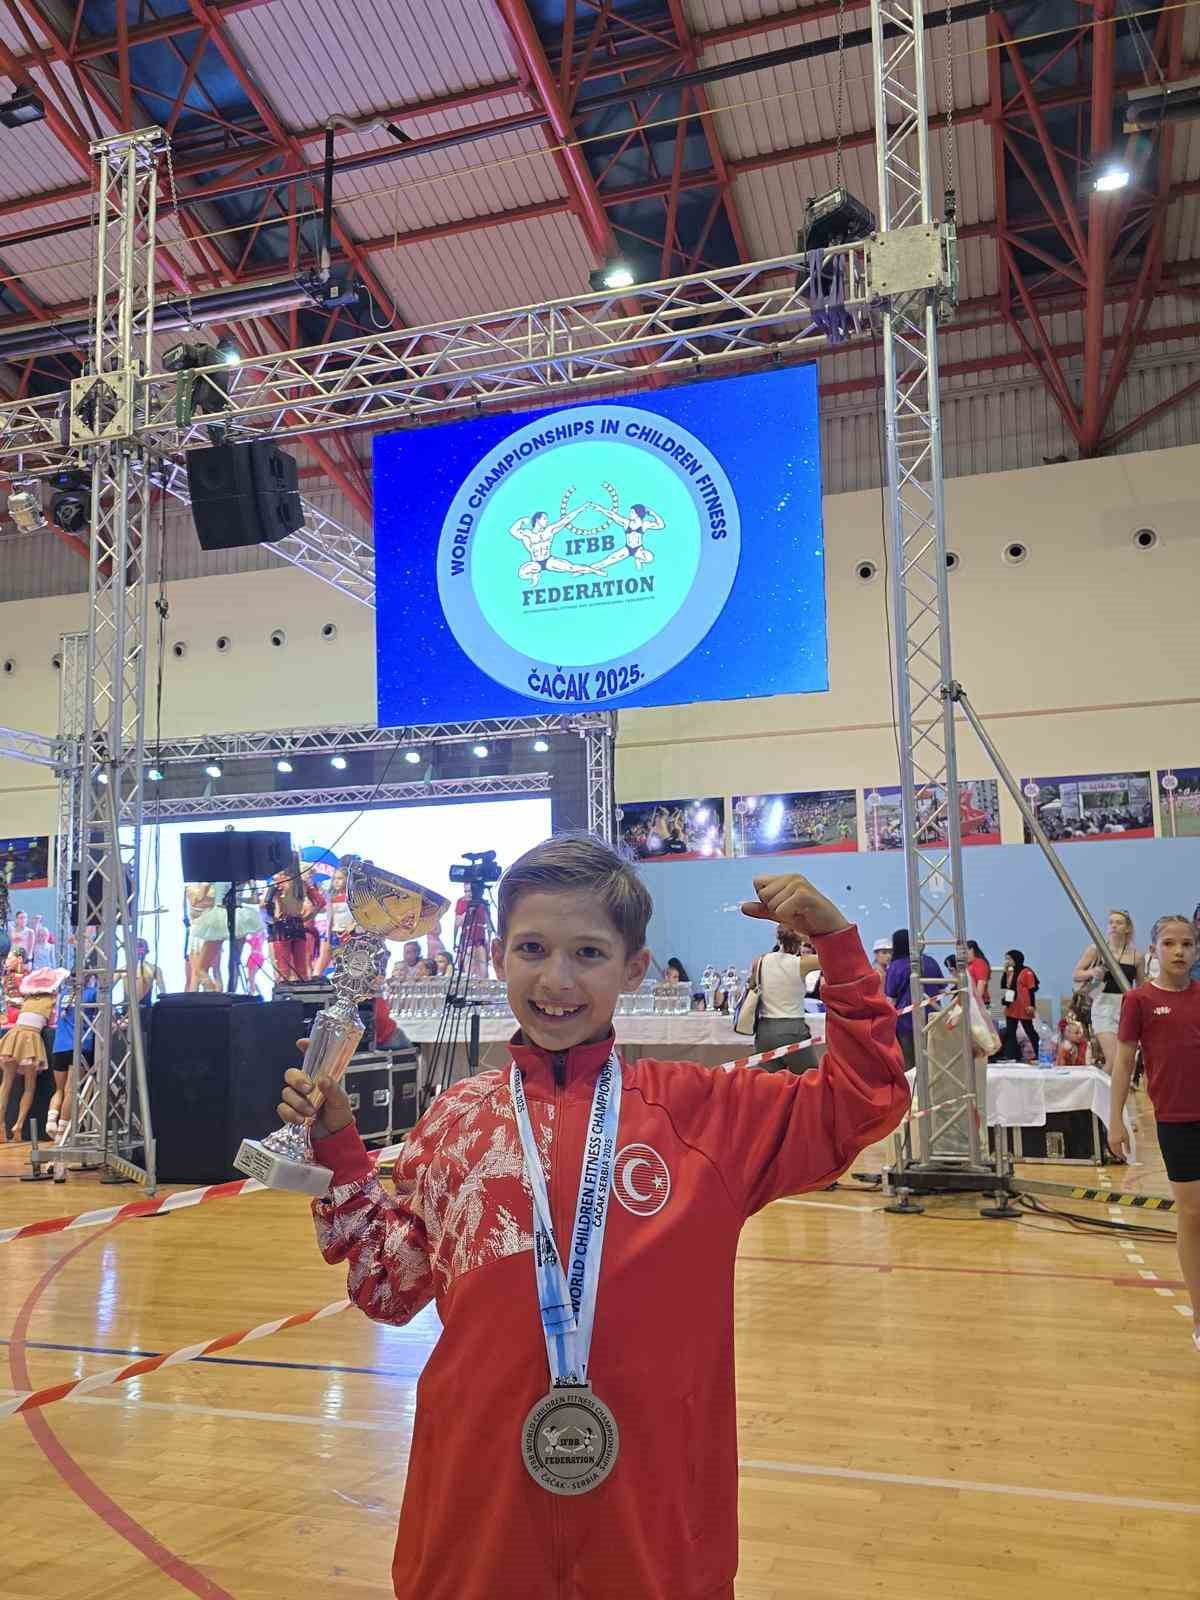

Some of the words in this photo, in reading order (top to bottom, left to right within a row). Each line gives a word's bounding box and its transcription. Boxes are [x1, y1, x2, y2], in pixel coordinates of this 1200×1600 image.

[451, 513, 474, 576] WORLD
[468, 419, 594, 509] CHAMPIONSHIPS
[600, 419, 620, 434] IN
[625, 423, 702, 476] CHILDREN
[695, 473, 727, 540] FITNESS
[565, 535, 616, 556] IFBB
[522, 576, 655, 606] FEDERATION
[527, 667, 590, 701] ČAČAK
[595, 664, 645, 698] 2025.
[591, 1053, 614, 1134] CHAMPIONSHI
[584, 1136, 602, 1184] FITNESS
[603, 1138, 613, 1158] 2025
[599, 1161, 610, 1194] SERBIA
[574, 1188, 595, 1255] CHILDREN
[592, 1195, 605, 1228] ČAČAK
[570, 1259, 585, 1312] WORLD
[545, 1455, 595, 1465] FEDERATION
